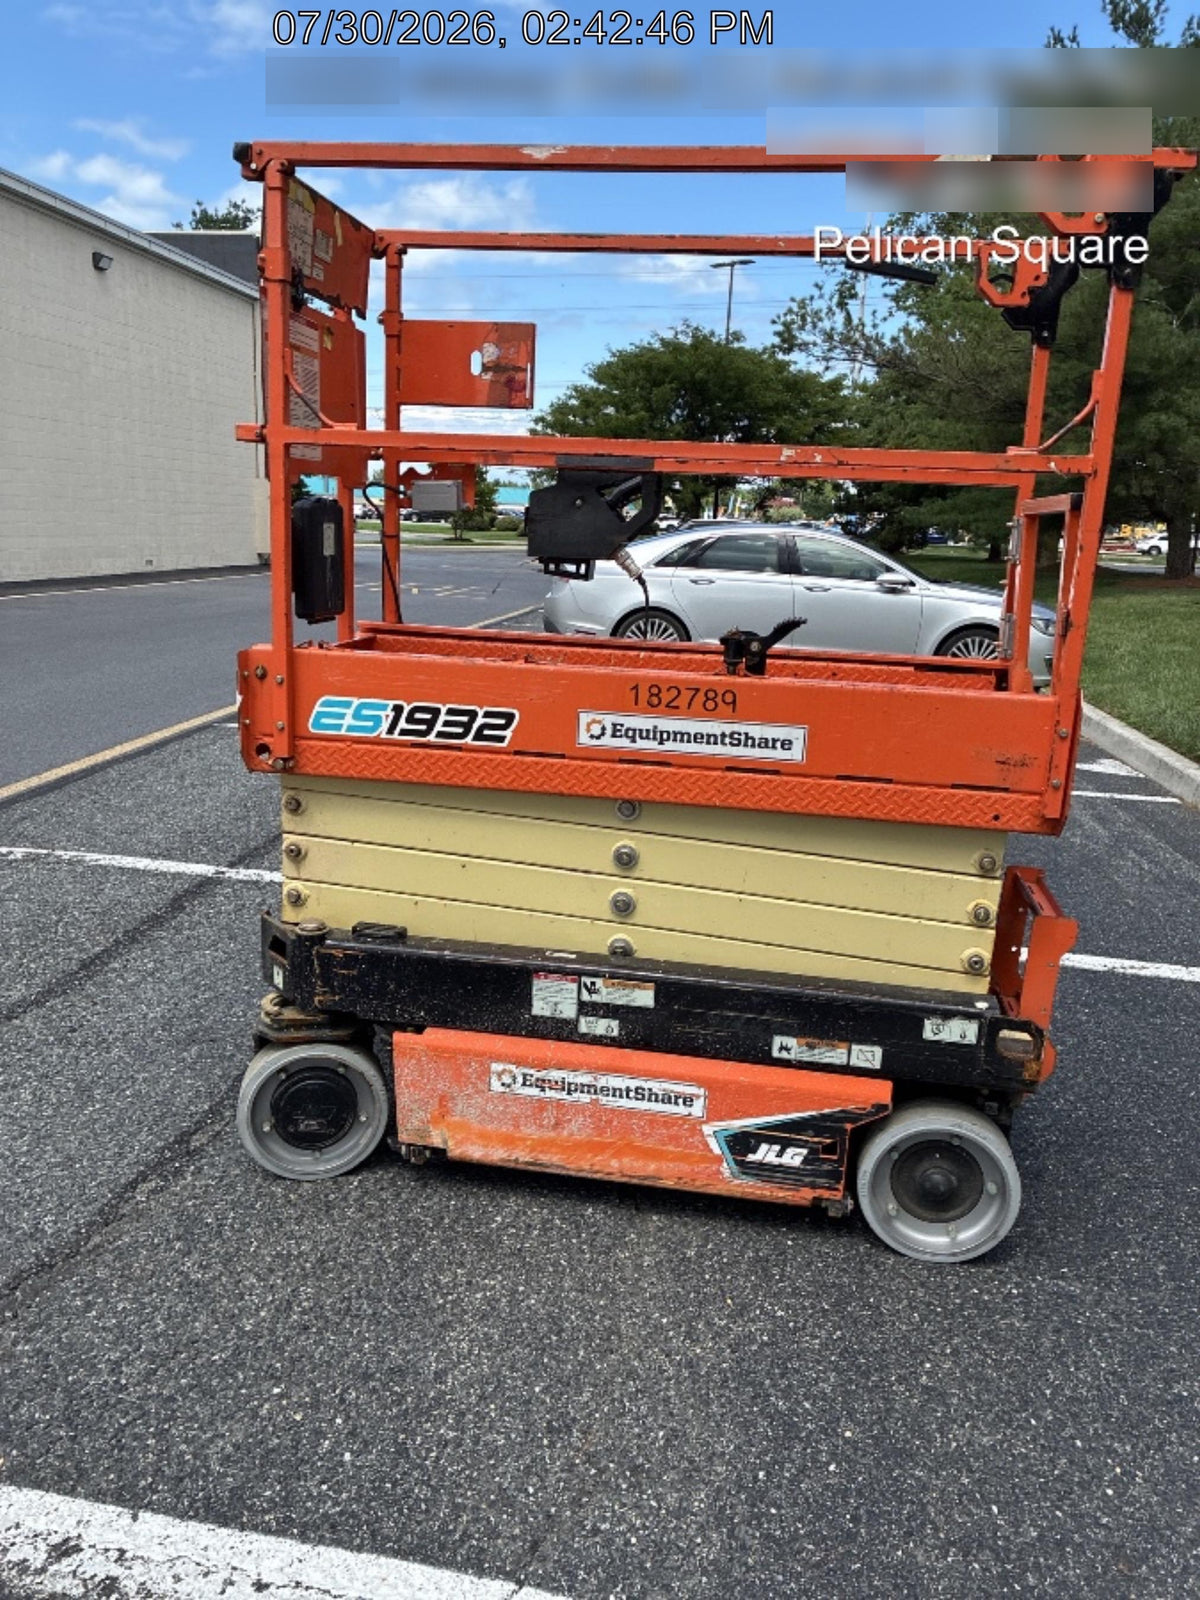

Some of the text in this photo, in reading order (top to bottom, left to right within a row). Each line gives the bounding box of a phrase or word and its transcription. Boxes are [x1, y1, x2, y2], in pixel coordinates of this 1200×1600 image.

[629, 683, 738, 713] 182789
[310, 697, 517, 744] ES1932
[610, 721, 794, 751] EquipmentShare
[520, 1072, 695, 1108] EquipmentShare
[745, 1142, 808, 1168] JLG
